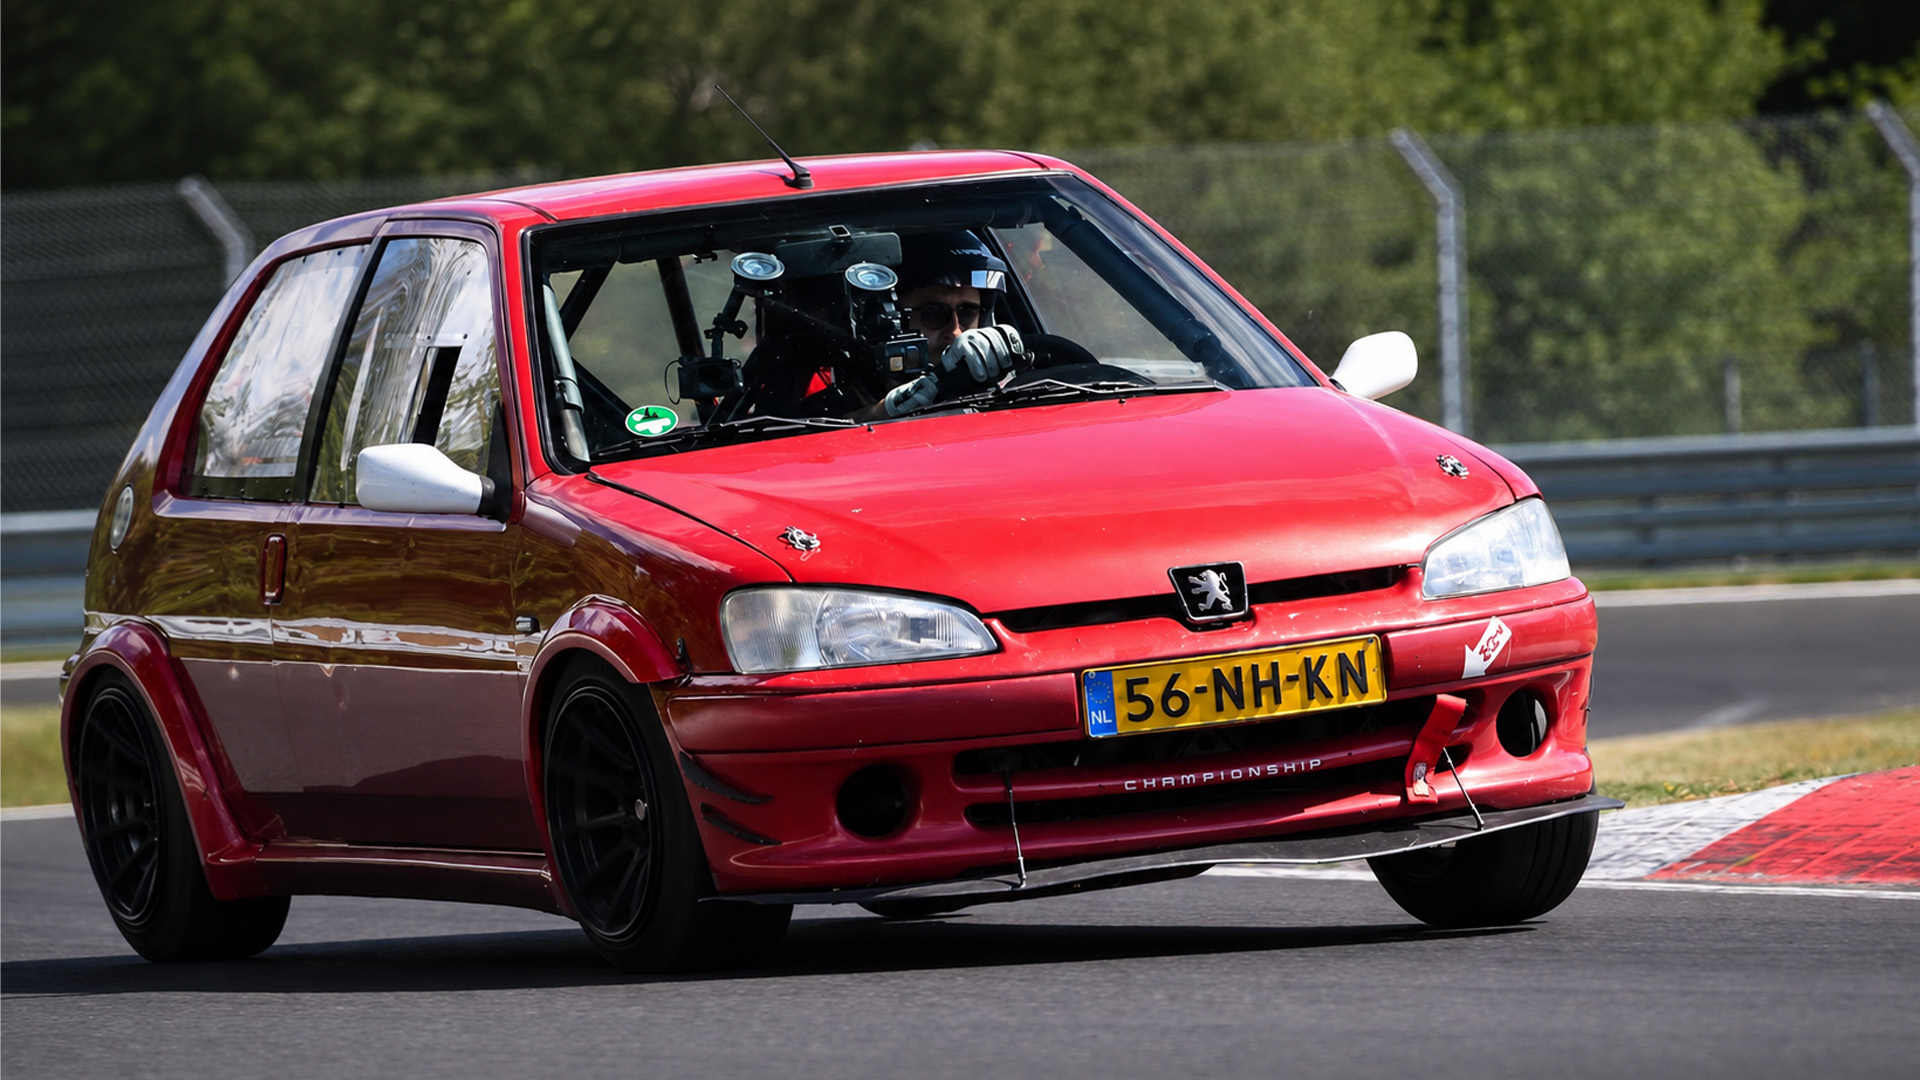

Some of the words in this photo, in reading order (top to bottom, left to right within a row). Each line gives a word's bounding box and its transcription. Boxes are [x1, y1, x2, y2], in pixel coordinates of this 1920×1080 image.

[1126, 650, 1369, 722] 56-NH-KN
[1091, 710, 1112, 725] NL
[1124, 759, 1322, 790] CHAMPIONSHIP
